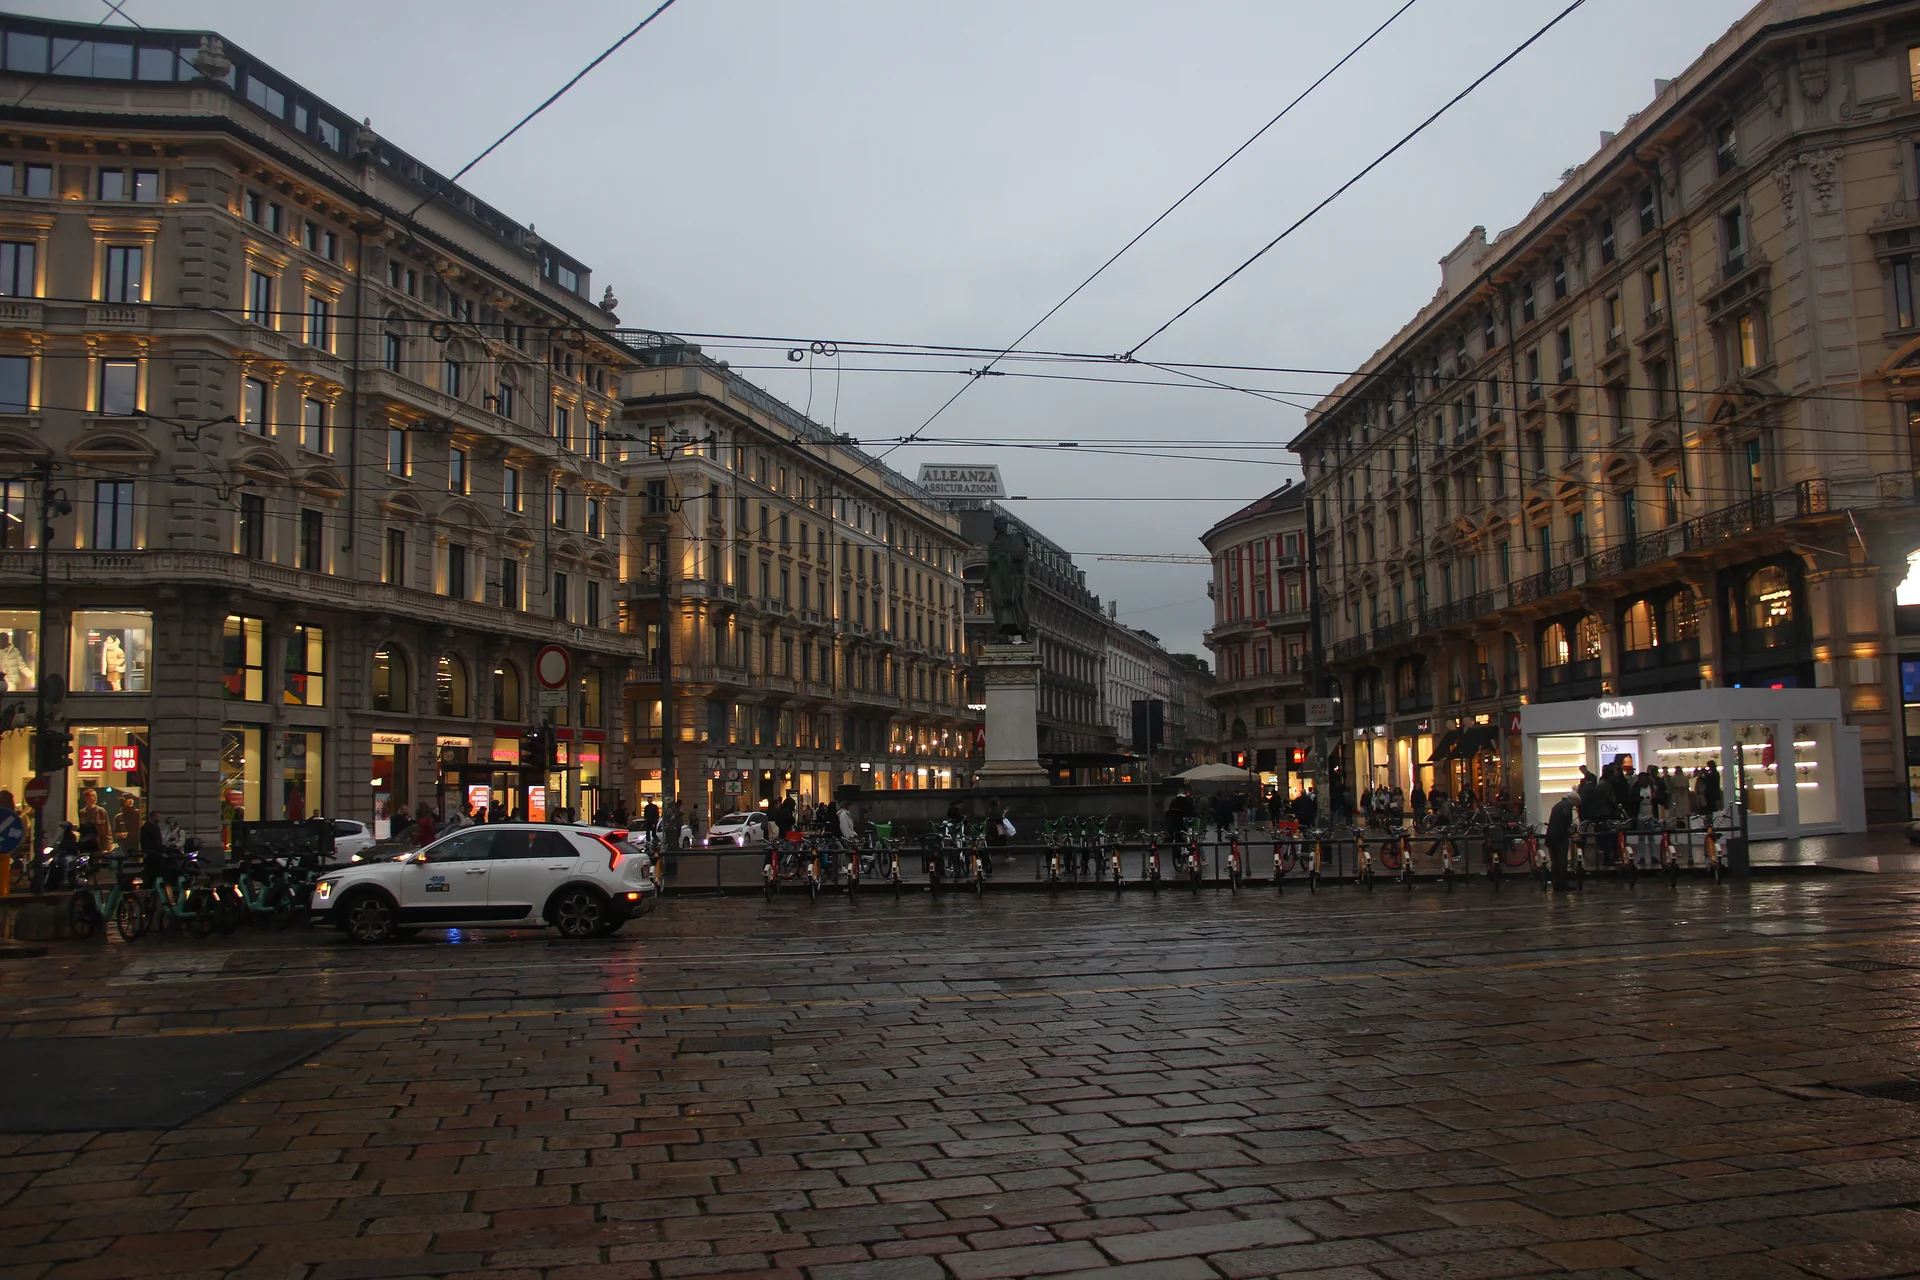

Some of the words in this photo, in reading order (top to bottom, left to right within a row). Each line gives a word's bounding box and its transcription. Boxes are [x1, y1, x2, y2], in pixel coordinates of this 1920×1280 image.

[923, 470, 996, 482] ALLEANZA
[923, 483, 997, 493] ASSICURAZIONI
[1598, 702, 1633, 718] Chloé
[1601, 744, 1618, 752] Chloé
[115, 749, 134, 758] UNI
[114, 759, 136, 770] QLO
